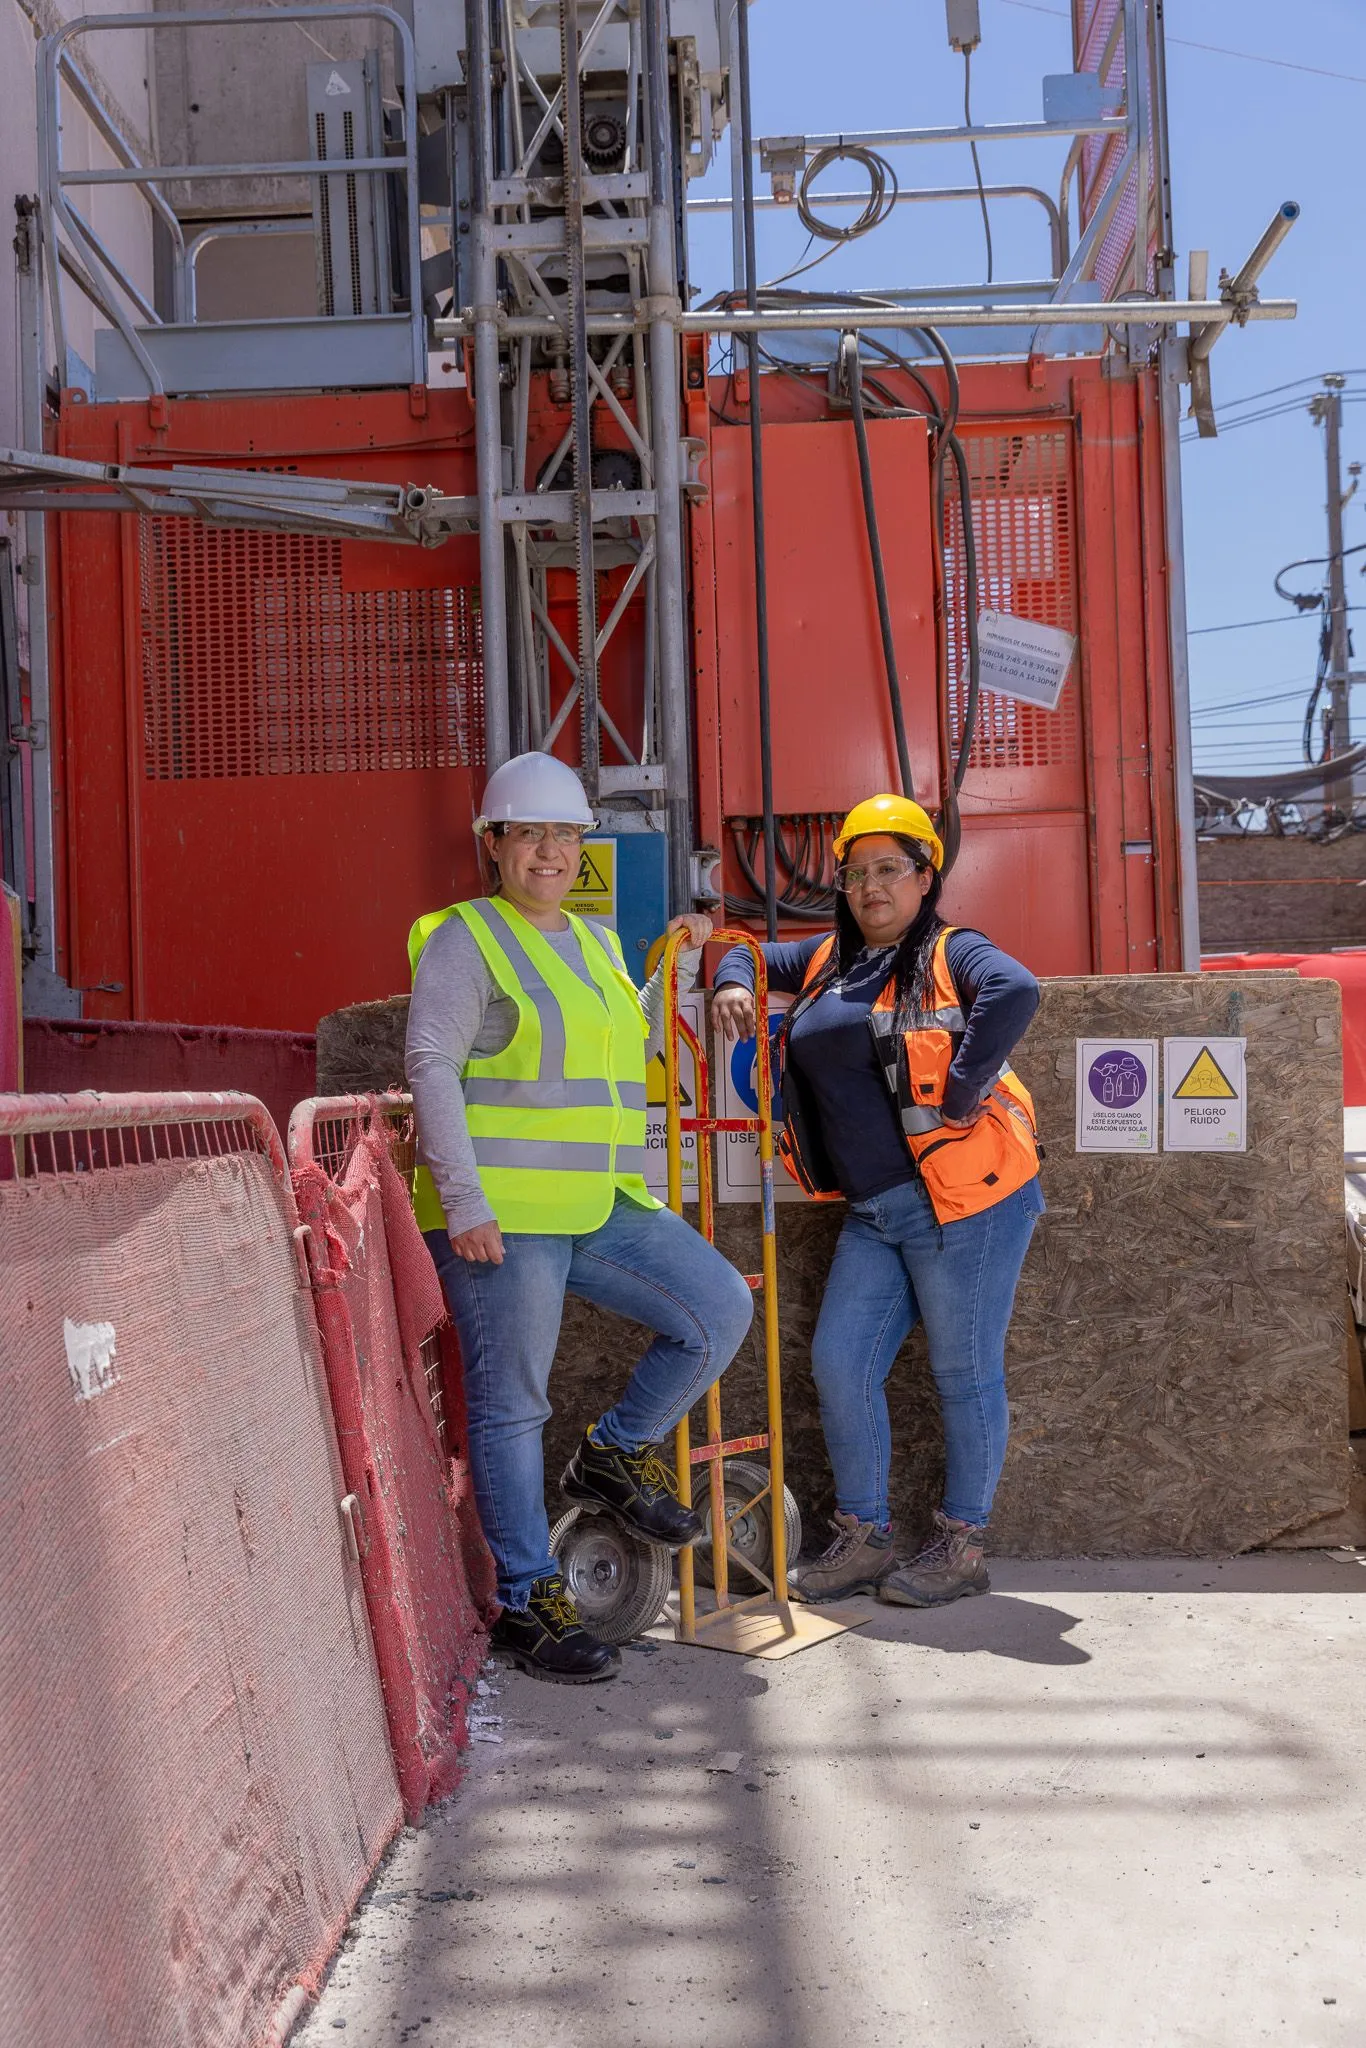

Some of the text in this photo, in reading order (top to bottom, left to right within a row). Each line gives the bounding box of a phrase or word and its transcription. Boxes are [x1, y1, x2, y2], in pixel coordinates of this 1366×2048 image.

[986, 632, 1013, 645] HORARIOS
[1021, 641, 1061, 658] MONTACARGAS
[999, 665, 1019, 677] 14:00
[1029, 661, 1045, 672] 8:30
[1045, 667, 1059, 676] AM
[1184, 1108, 1227, 1116] PELIGRO
[1190, 1116, 1221, 1125] RUIDO
[729, 1132, 757, 1144] USE
